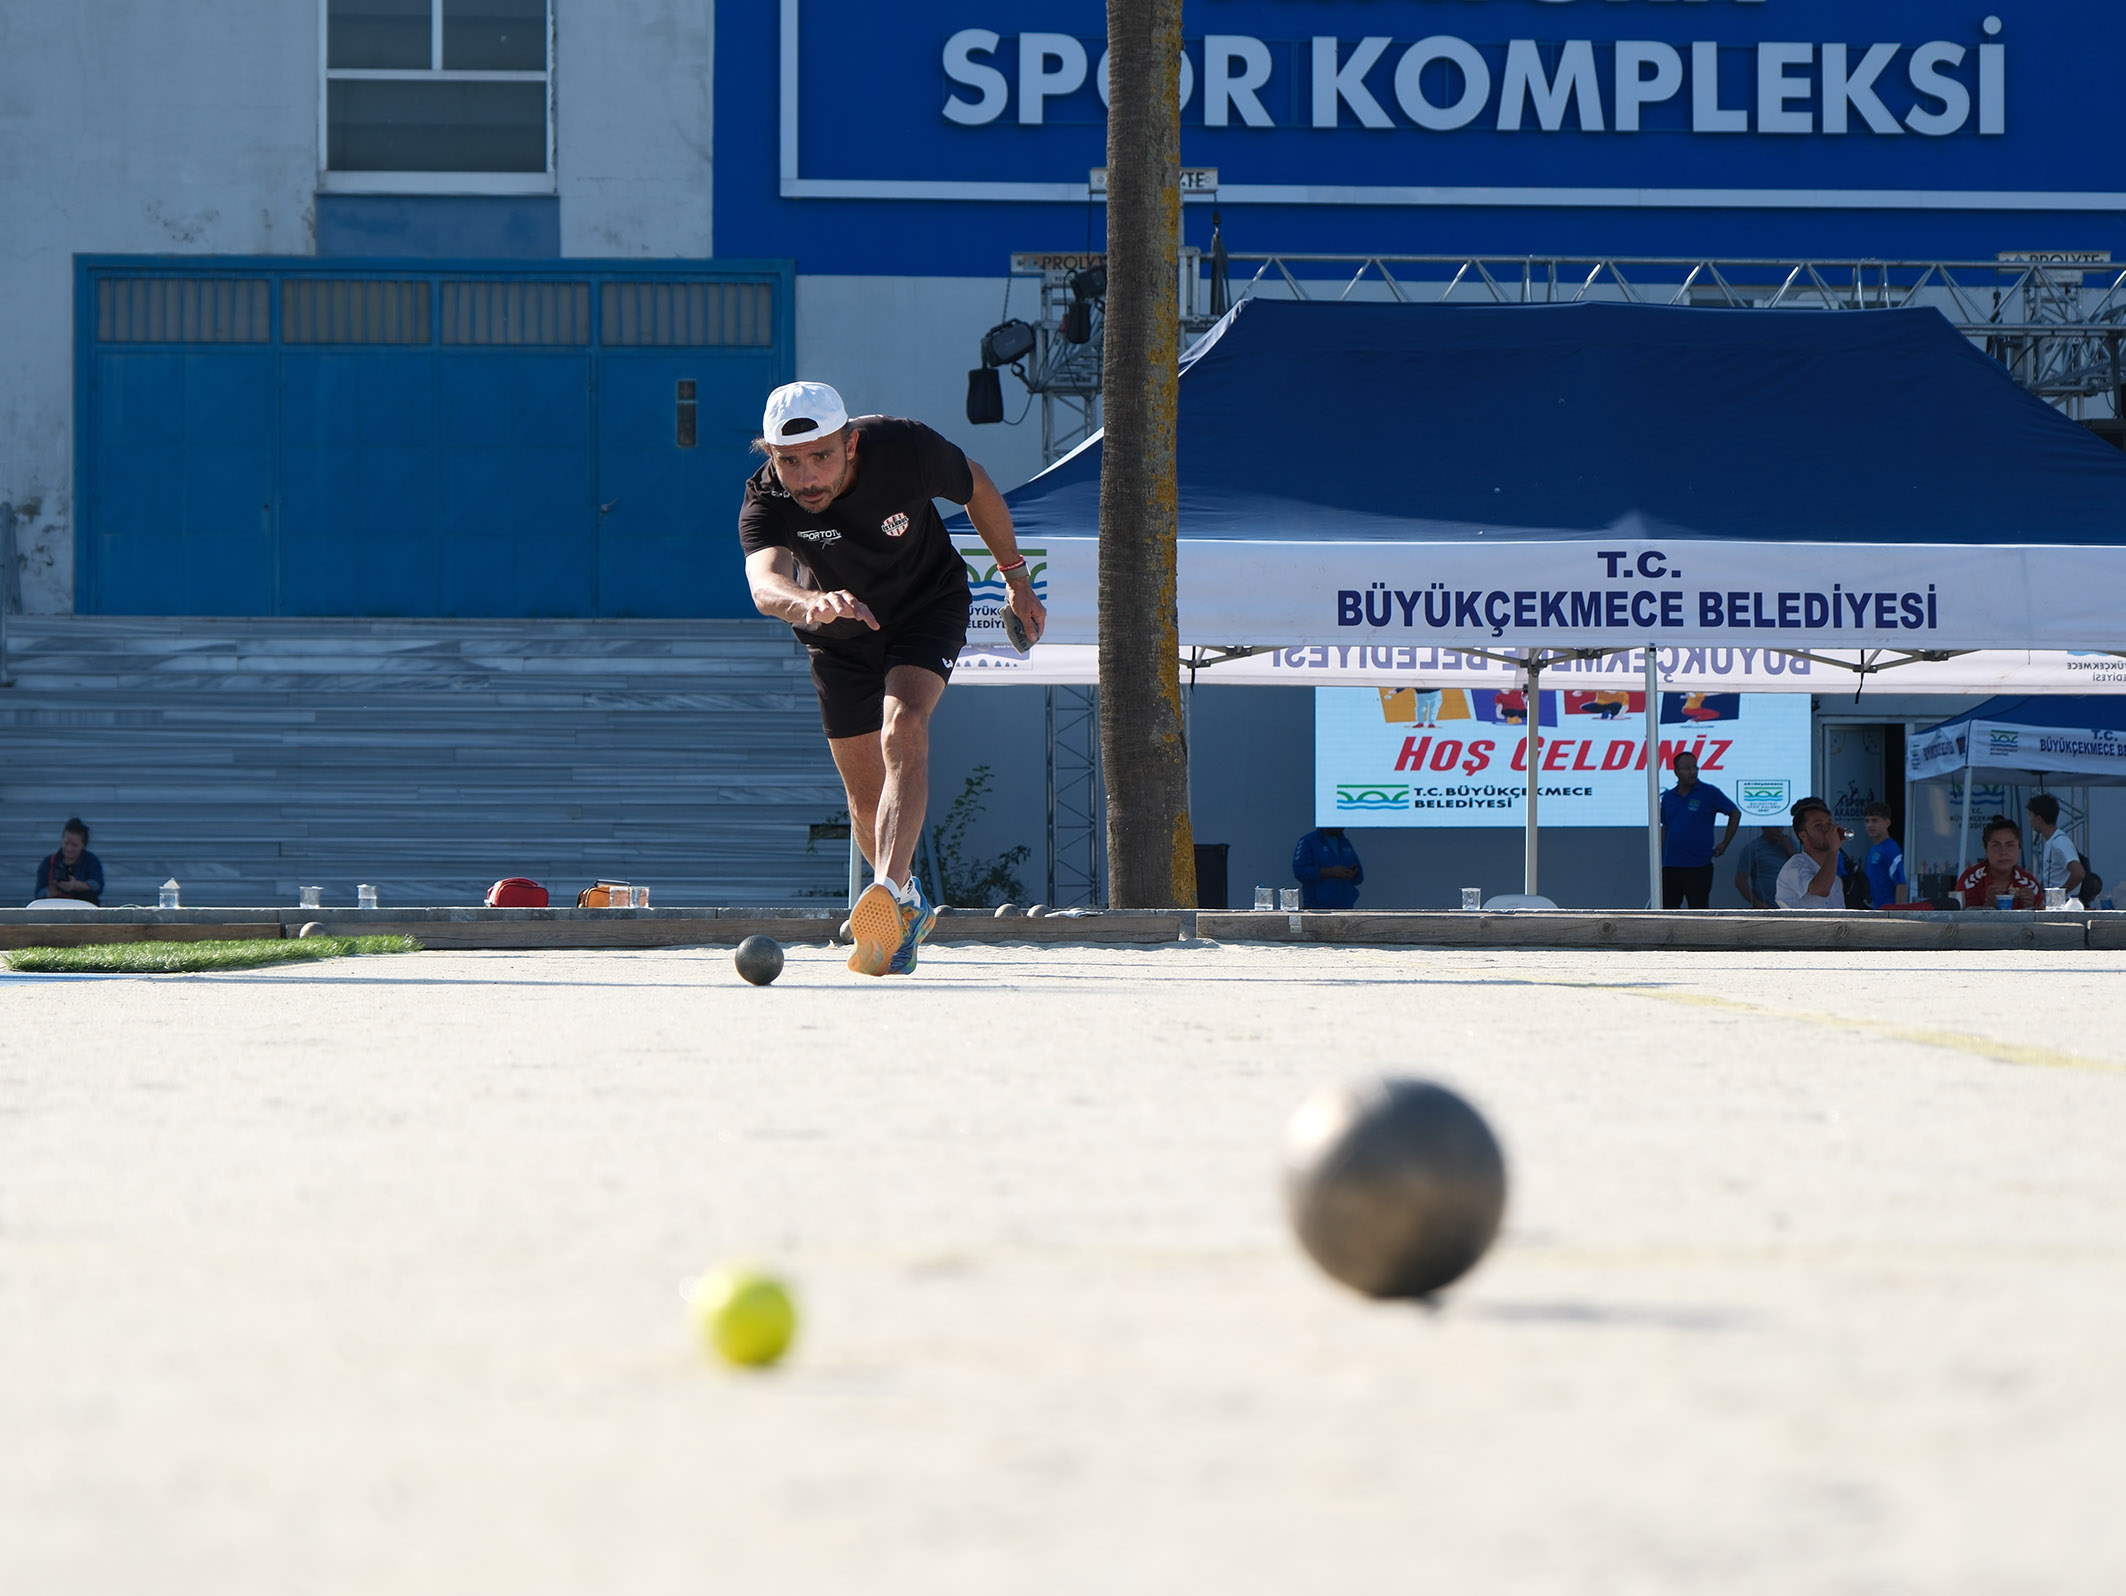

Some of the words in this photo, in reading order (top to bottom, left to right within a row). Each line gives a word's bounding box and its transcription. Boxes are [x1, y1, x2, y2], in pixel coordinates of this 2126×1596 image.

[942, 28, 1276, 127] SPR
[1311, 15, 2005, 136] KOMPLEKSİ
[1597, 551, 1682, 579] T.C.
[1337, 582, 1684, 638] BÜYÜKÇEKMECE
[1699, 582, 1937, 630] BELEDİYESİ
[1394, 736, 1496, 776] HOŞ
[2040, 736, 2114, 758] BÜYÜKÇEKMECE
[1414, 787, 1443, 797] T.C.
[1414, 796, 1512, 808] BELEDİYESİ
